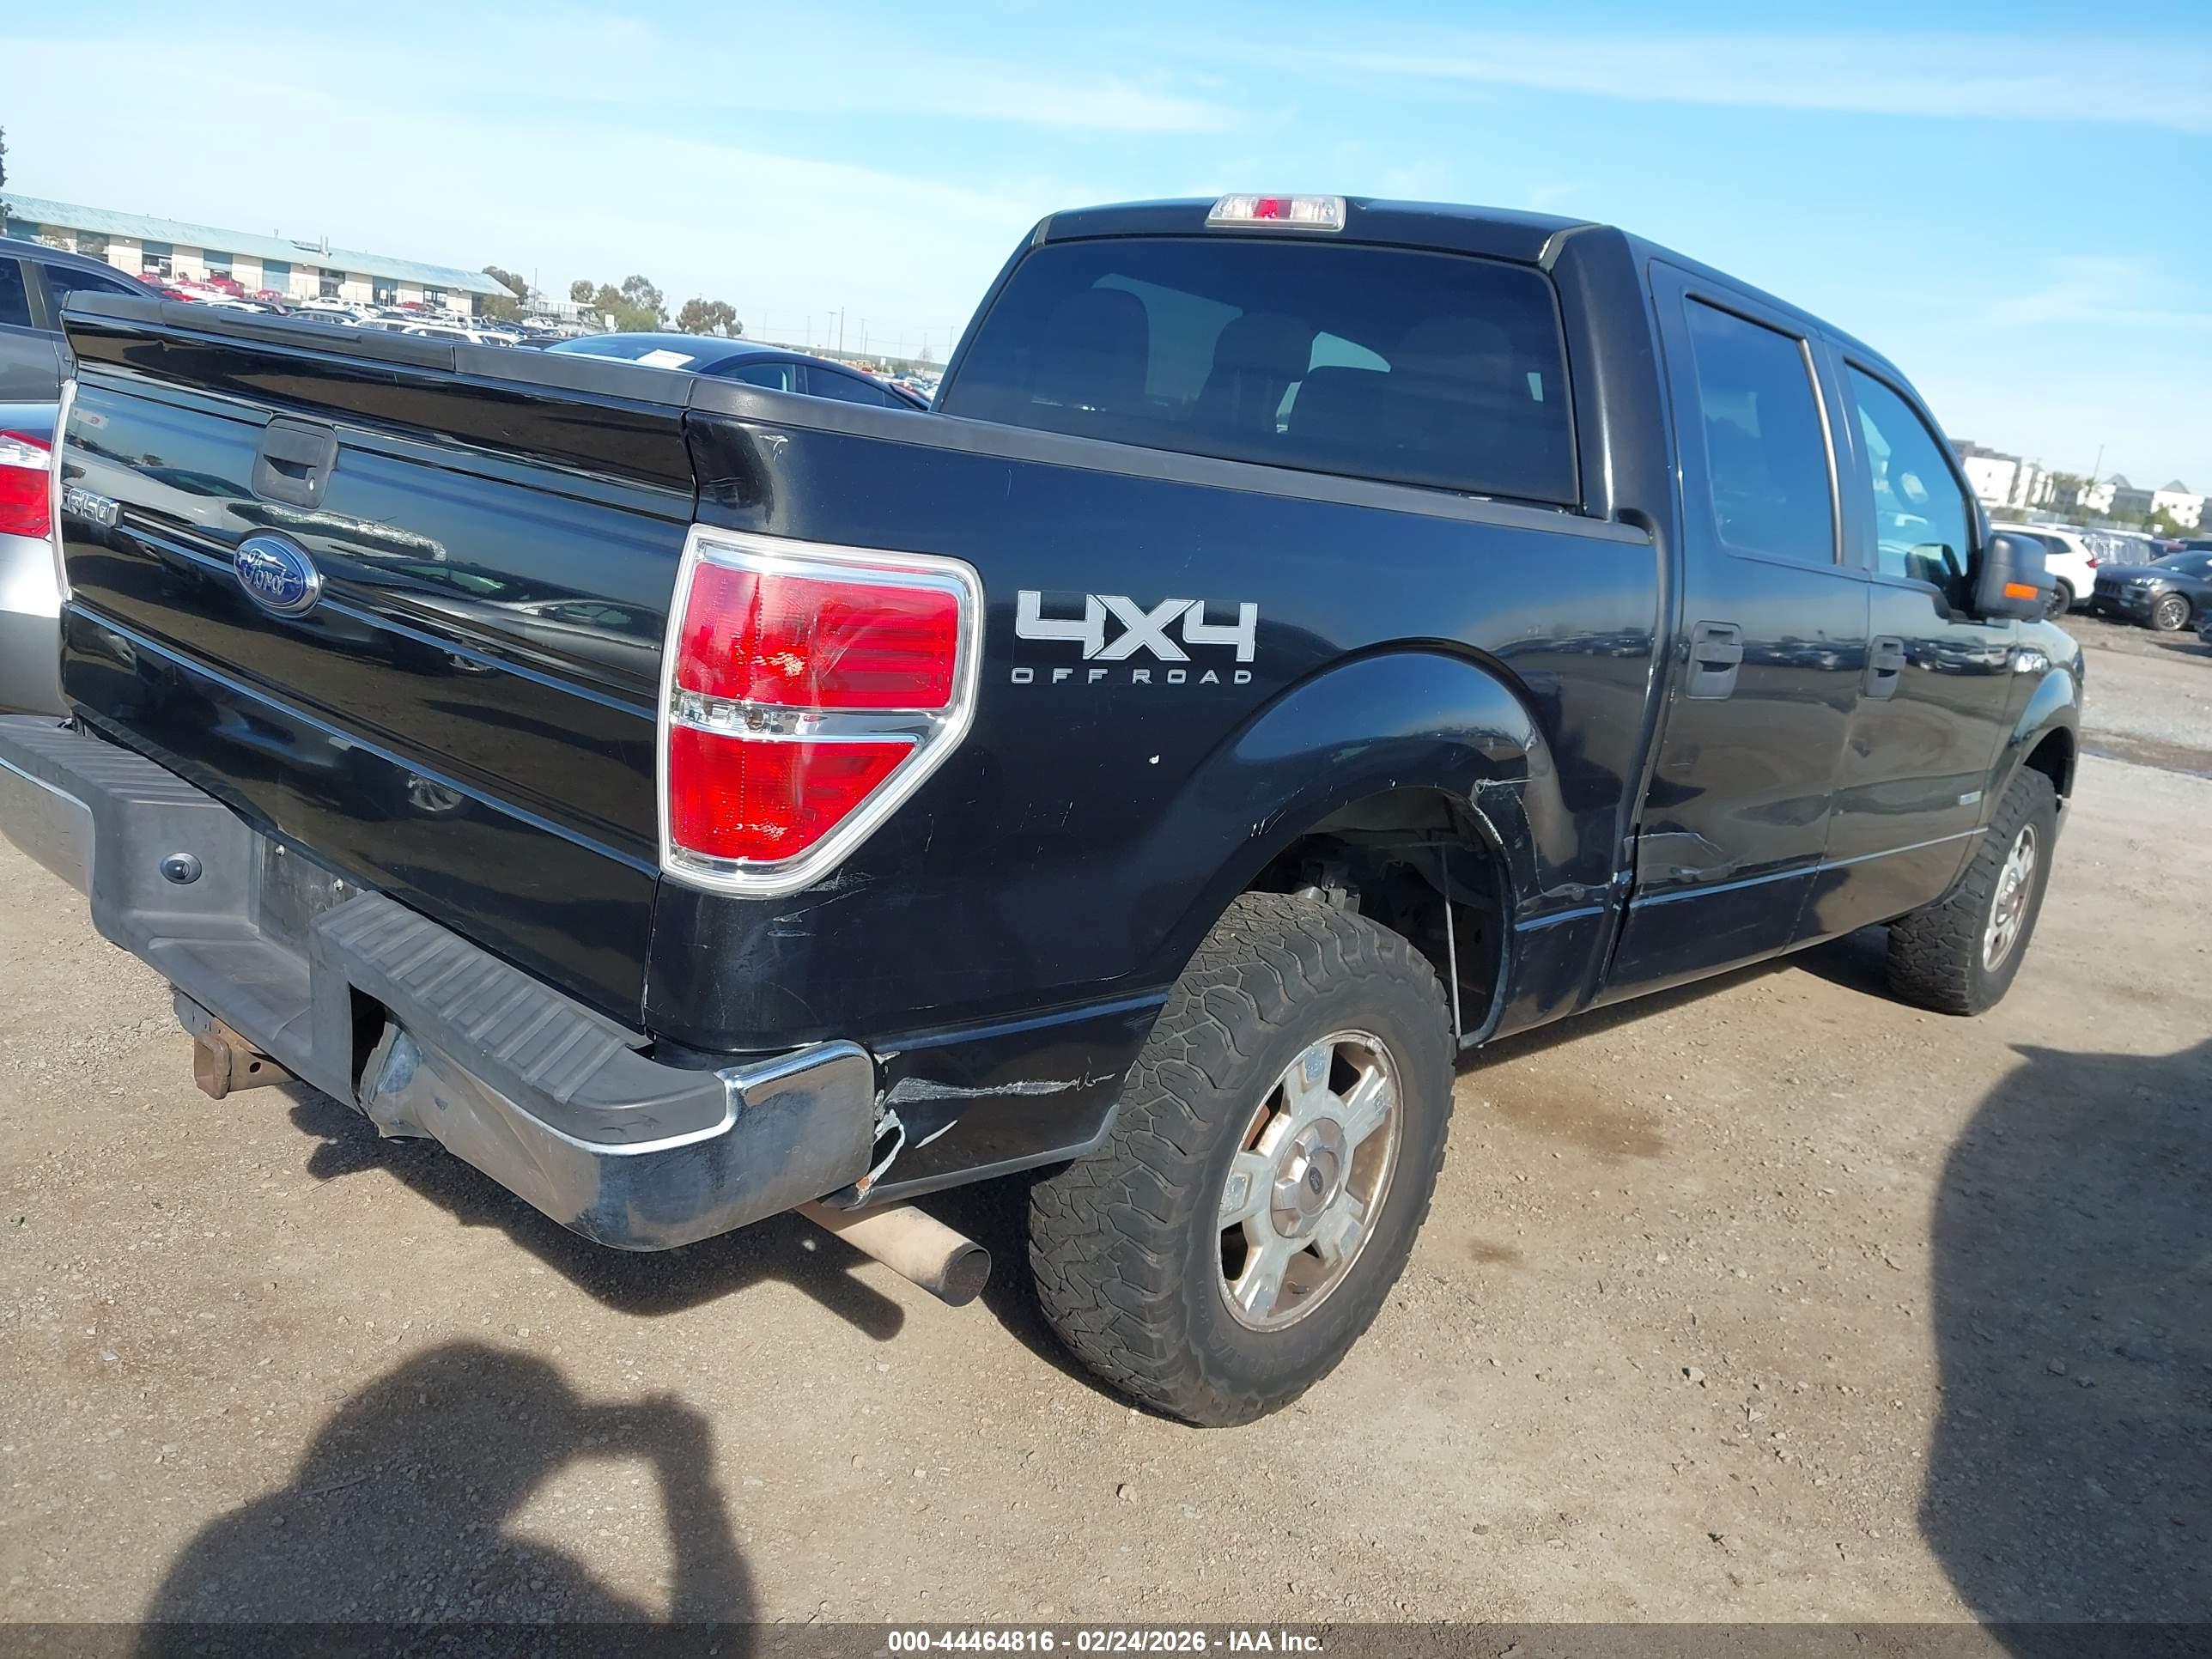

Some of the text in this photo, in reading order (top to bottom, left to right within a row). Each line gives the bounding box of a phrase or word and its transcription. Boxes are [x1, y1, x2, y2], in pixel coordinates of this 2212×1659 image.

[243, 548, 288, 596] Ford
[1016, 590, 1258, 662] 4X4
[1011, 667, 1253, 685] OFF ROAD
